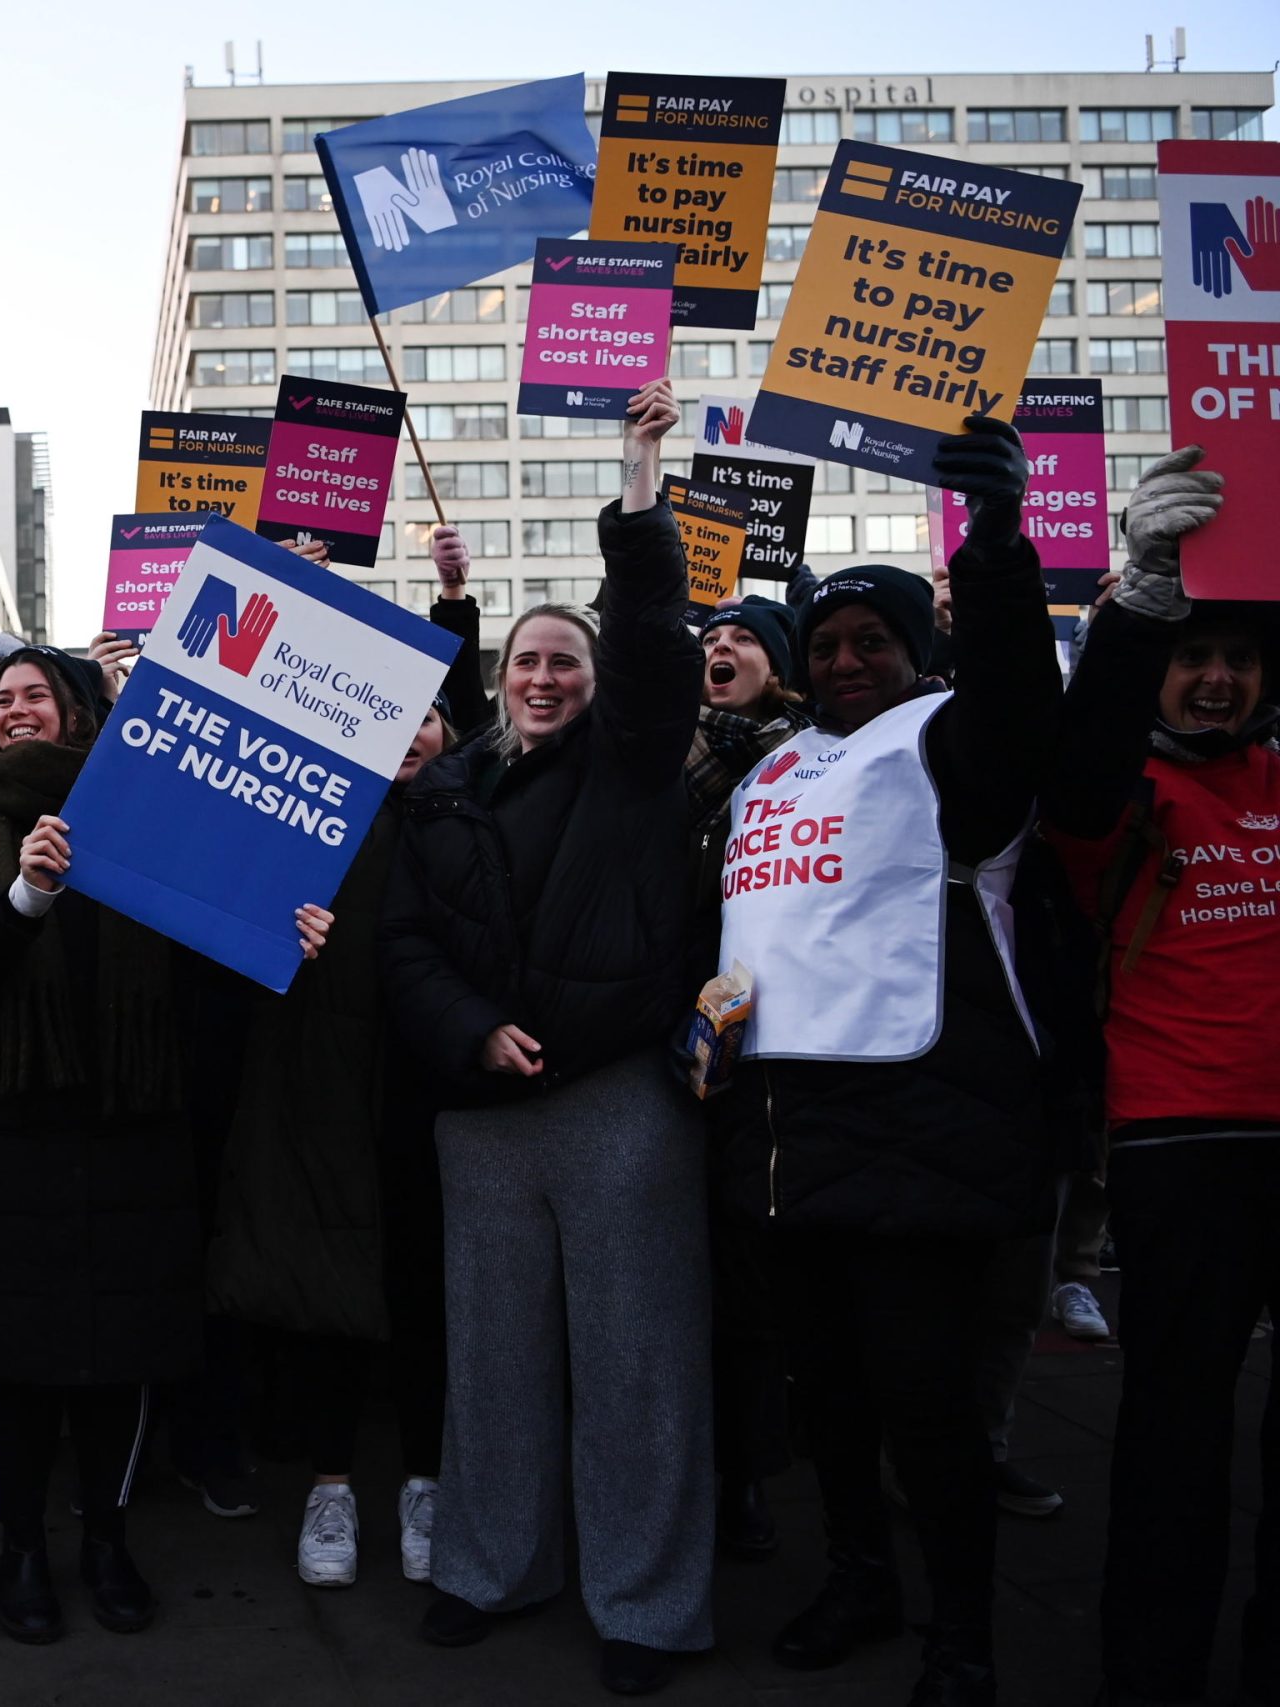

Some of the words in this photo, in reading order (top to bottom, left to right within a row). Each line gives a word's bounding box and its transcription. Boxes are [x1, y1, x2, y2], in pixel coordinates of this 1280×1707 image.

[655, 96, 695, 111] FAIR
[698, 98, 733, 113] PAY
[786, 77, 934, 111] ospital
[654, 111, 688, 126] FOR
[692, 113, 769, 129] NURSING
[453, 154, 514, 194] Royal
[518, 152, 597, 180] College
[676, 153, 744, 178] time
[467, 194, 487, 219] of
[489, 170, 574, 208] Nursing
[638, 183, 667, 204] to
[673, 188, 727, 212] pay
[899, 170, 956, 195] FAIR
[960, 182, 1012, 206] PAY
[894, 190, 944, 213] FOR
[948, 201, 1061, 236] NURSING
[624, 213, 733, 242] nursing
[577, 256, 606, 266] SAFE
[608, 258, 663, 269] STAFFING
[677, 243, 749, 273] fairly
[576, 266, 610, 275] SAVES
[613, 267, 644, 276] LIVES
[918, 250, 1015, 294] time
[571, 302, 628, 320] Staff
[852, 277, 895, 307] to
[903, 292, 985, 332] pay
[538, 323, 655, 347] shortages
[824, 314, 987, 374] nursing
[539, 349, 588, 365] cost
[595, 349, 648, 367] lives
[785, 346, 888, 386] staff
[893, 364, 1004, 418] fairly
[316, 398, 343, 409] SAFE
[344, 401, 394, 416] STAFFING
[1026, 395, 1095, 406] STAFFING
[1035, 407, 1074, 417] LIVES
[1191, 387, 1255, 420] OF
[178, 440, 204, 451] FOR
[207, 442, 265, 455] NURSING
[179, 429, 208, 441] FAIR
[211, 432, 237, 443] PAY
[307, 443, 358, 464] Staff
[197, 473, 247, 492] time
[276, 463, 379, 491] shortages
[747, 469, 794, 491] time
[168, 496, 191, 511] to
[196, 500, 236, 518] pay
[276, 488, 319, 506] cost
[324, 492, 371, 513] lives
[687, 499, 705, 510] FOR
[707, 503, 744, 520] NURSING
[688, 490, 710, 502] FAIR
[710, 495, 727, 507] PAY
[144, 525, 167, 533] SAFE
[169, 524, 205, 532] STAFFIN
[697, 526, 730, 545] time
[1028, 515, 1094, 538] lives
[693, 544, 720, 561] pay
[745, 543, 798, 568] fairly
[115, 581, 175, 593] shorta
[690, 577, 728, 598] fairly
[117, 599, 155, 611] cost
[272, 642, 331, 692] Royal
[331, 671, 403, 722] College
[259, 670, 285, 697] of
[284, 681, 362, 739] Nursing
[155, 687, 232, 747] THE
[237, 727, 352, 807] VOICE
[120, 717, 178, 758] OF
[177, 744, 349, 847] NURSING
[790, 815, 845, 847] OF
[725, 824, 783, 865] OICE
[1172, 844, 1245, 866] SAVE
[721, 854, 842, 900] URSING
[1195, 880, 1255, 899] Save
[1180, 900, 1276, 926] Hospital
